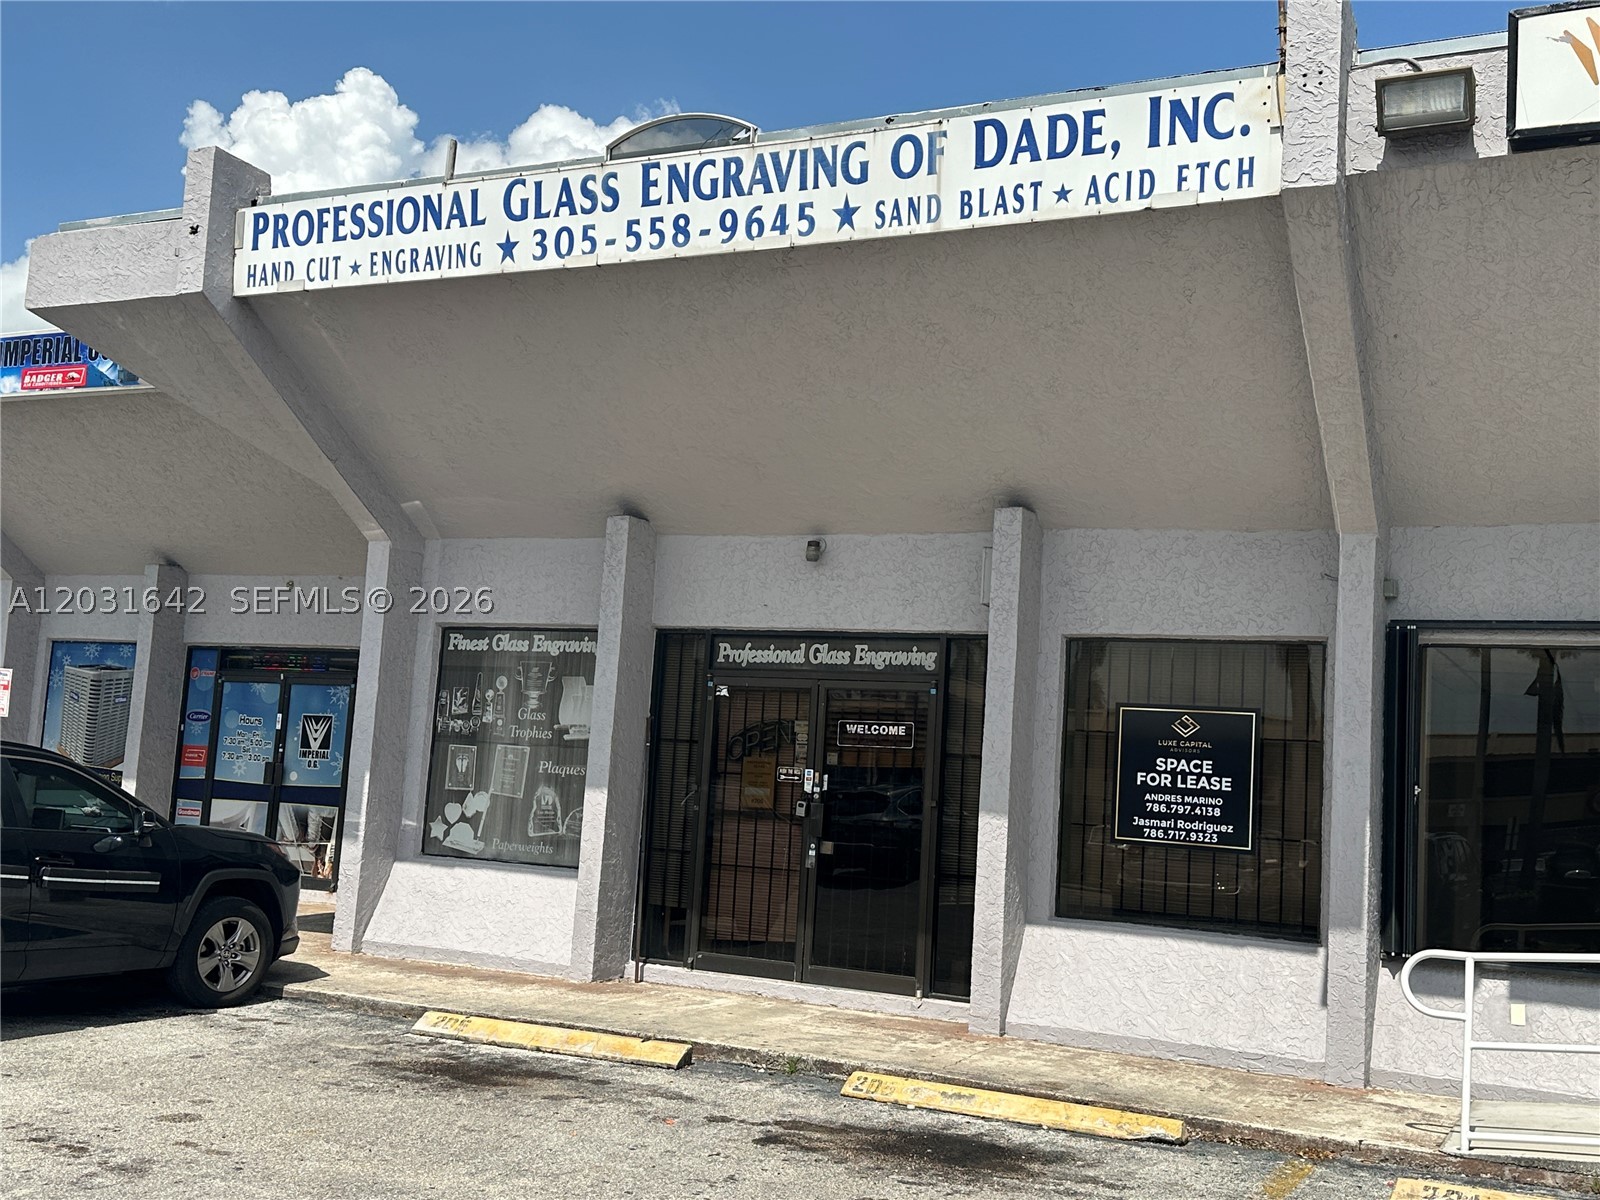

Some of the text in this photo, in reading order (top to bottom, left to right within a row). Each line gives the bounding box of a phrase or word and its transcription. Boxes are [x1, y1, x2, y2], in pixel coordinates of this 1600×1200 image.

[250, 92, 1251, 251] PROFESSIONAL GLASS ENGRAVING OF DADE, INC.
[874, 156, 1255, 230] SAND BLAST ACID ETCH
[531, 201, 816, 262] 305-558-9645
[246, 241, 482, 288] HAND CUT ENGRAVING
[23, 373, 63, 383] BADGER
[448, 633, 598, 656] Finest Glass Engravin
[717, 642, 938, 670] Professional Glass Engraving
[188, 713, 210, 721] Carrier
[239, 714, 263, 726] Hours
[517, 707, 547, 721] Glass
[510, 726, 553, 739] Trophies
[845, 723, 907, 736] WELCOME
[728, 720, 791, 760] OPEN
[299, 749, 330, 759] IMPERIAL
[538, 761, 585, 776] Plaques
[1155, 757, 1213, 774] SPACE
[1136, 772, 1232, 791] FOR LEASE
[1144, 793, 1223, 806] ANDRES MARINO
[1146, 803, 1221, 817] 786.797.4138
[1132, 816, 1234, 833] Jasmari Rodriguez
[1143, 828, 1218, 843] 786.717.9323
[492, 838, 554, 856] Paperweights
